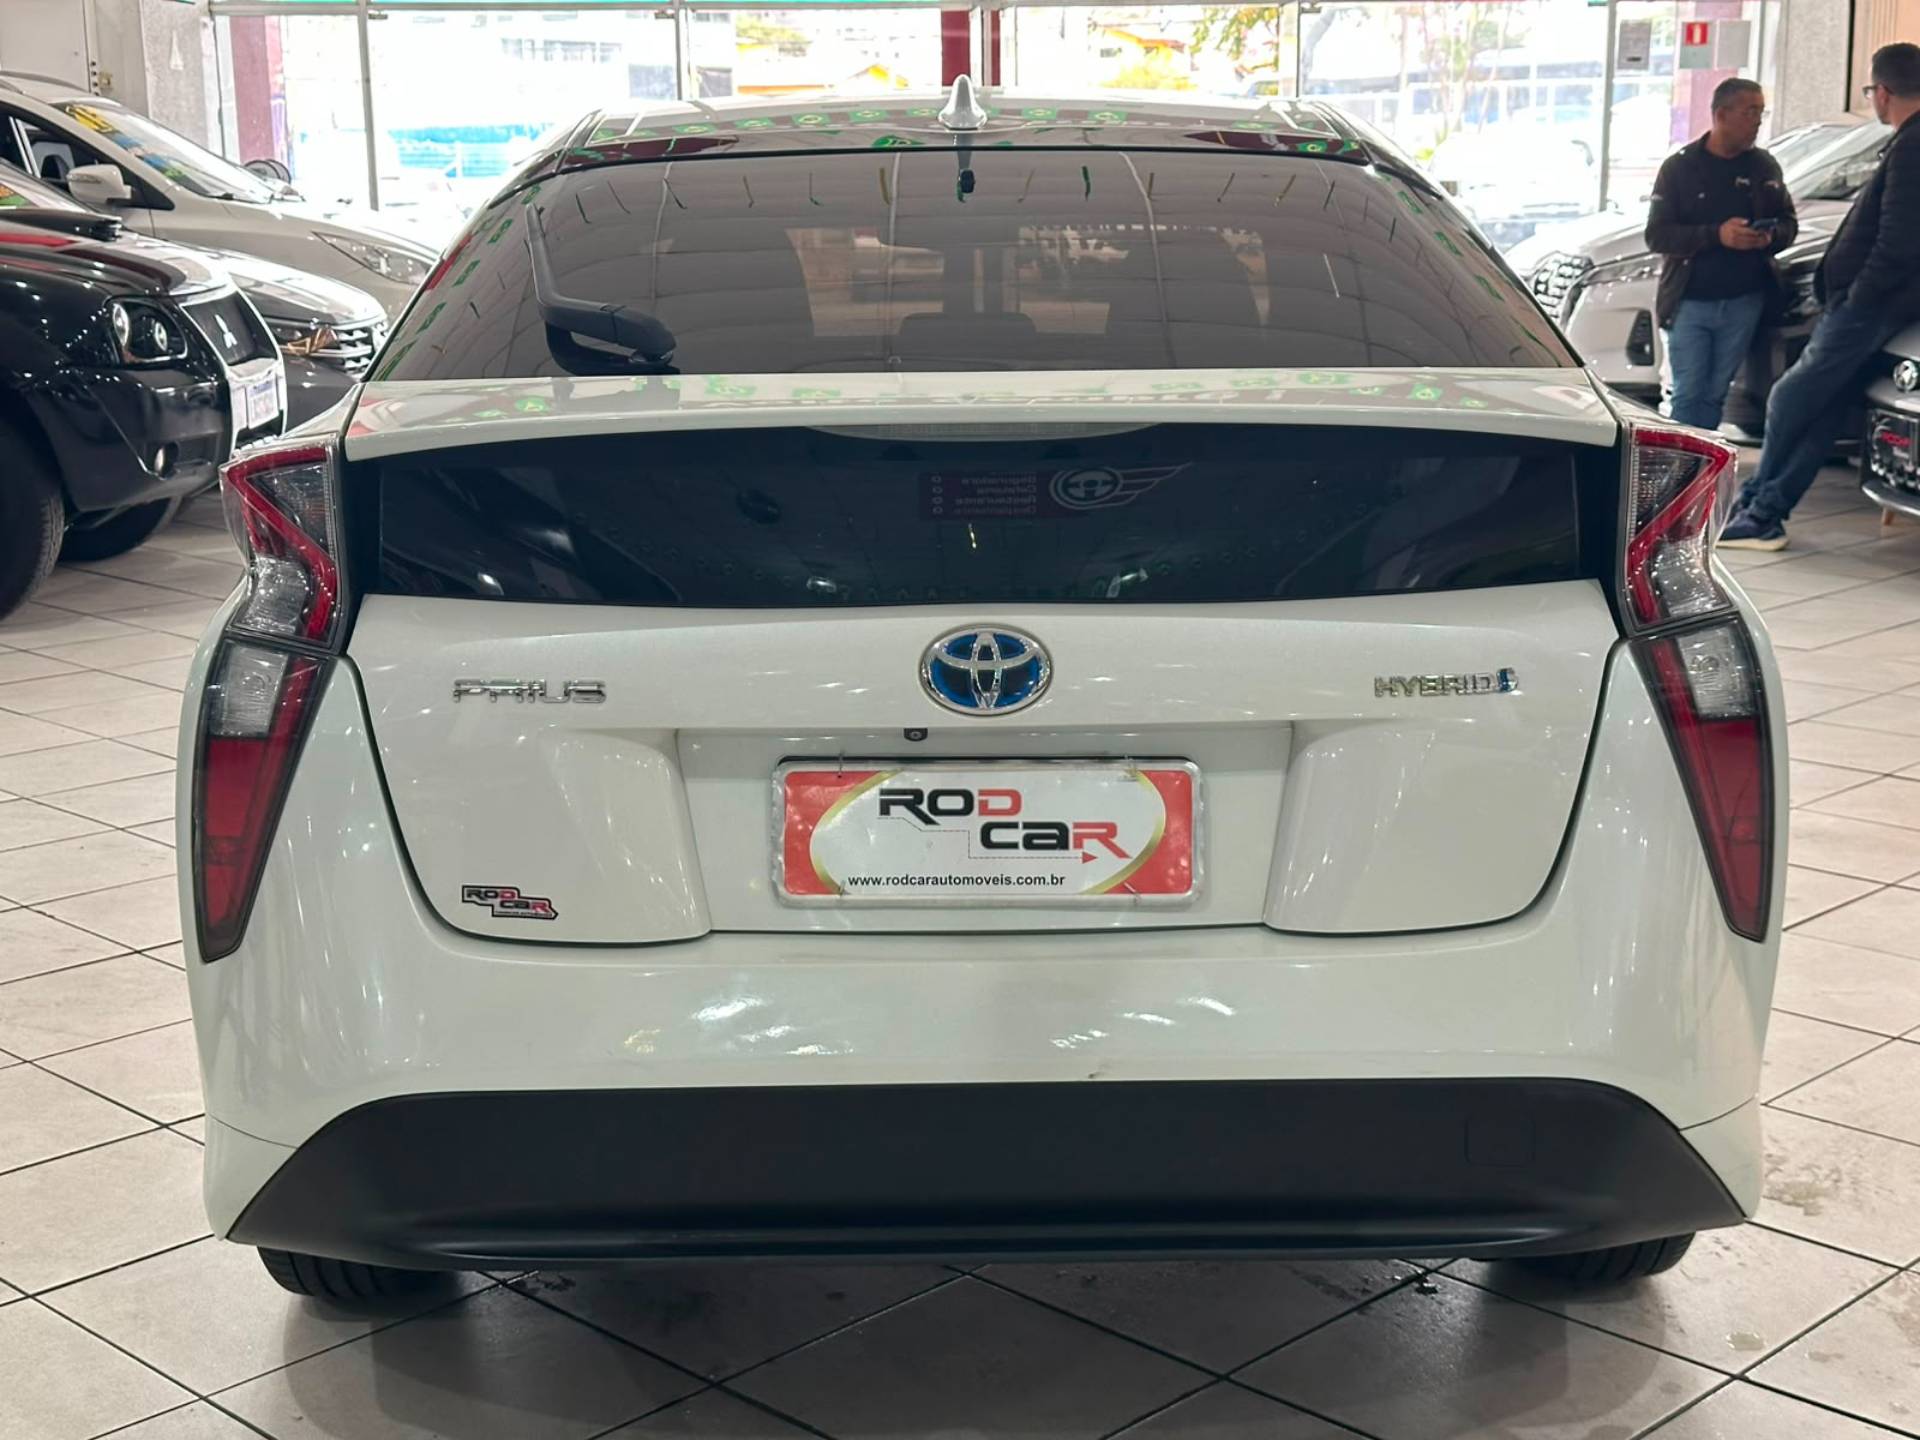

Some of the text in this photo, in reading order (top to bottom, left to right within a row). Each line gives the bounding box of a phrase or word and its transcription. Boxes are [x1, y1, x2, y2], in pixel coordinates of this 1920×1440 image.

[453, 679, 607, 703] PRIUS
[1374, 673, 1497, 697] HYBRID
[879, 788, 1022, 825] ROD
[848, 874, 1066, 887] www.rodcarautomoveis.com.br
[466, 889, 516, 901] ROD
